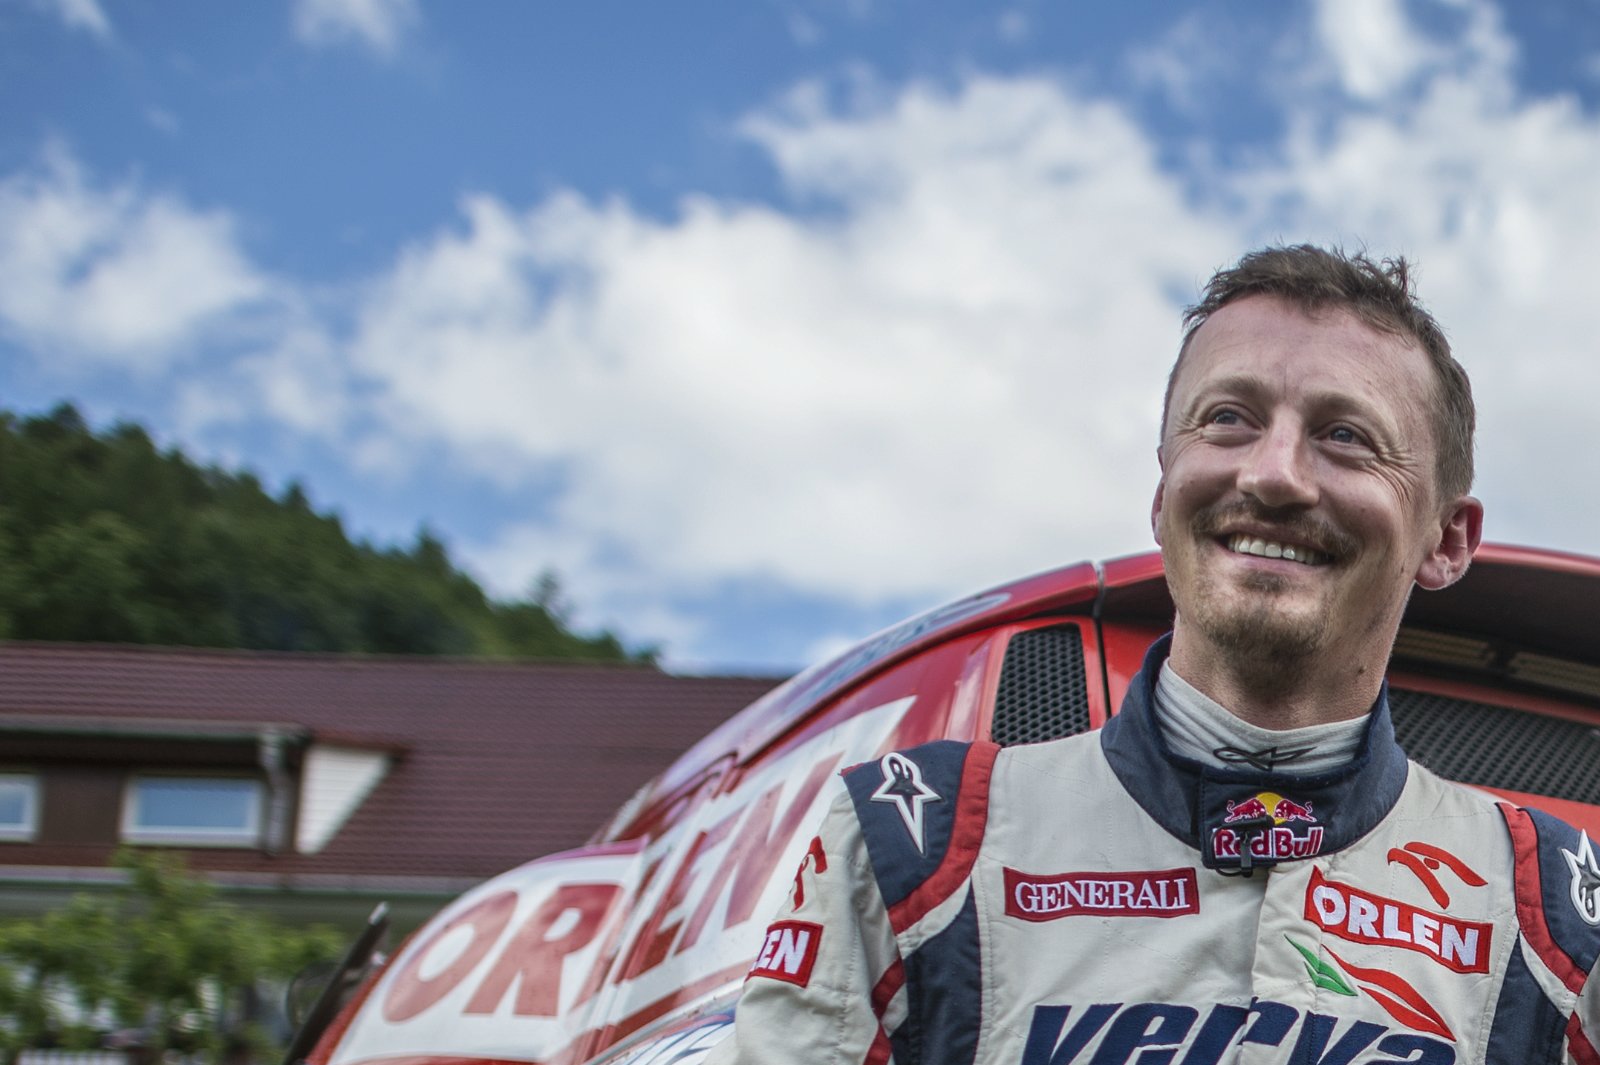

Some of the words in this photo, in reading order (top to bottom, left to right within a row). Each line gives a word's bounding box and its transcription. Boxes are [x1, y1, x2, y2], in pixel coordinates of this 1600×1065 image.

[1272, 826, 1324, 859] Bull
[1014, 877, 1190, 913] GENERALI
[1312, 884, 1479, 967] ORLEN
